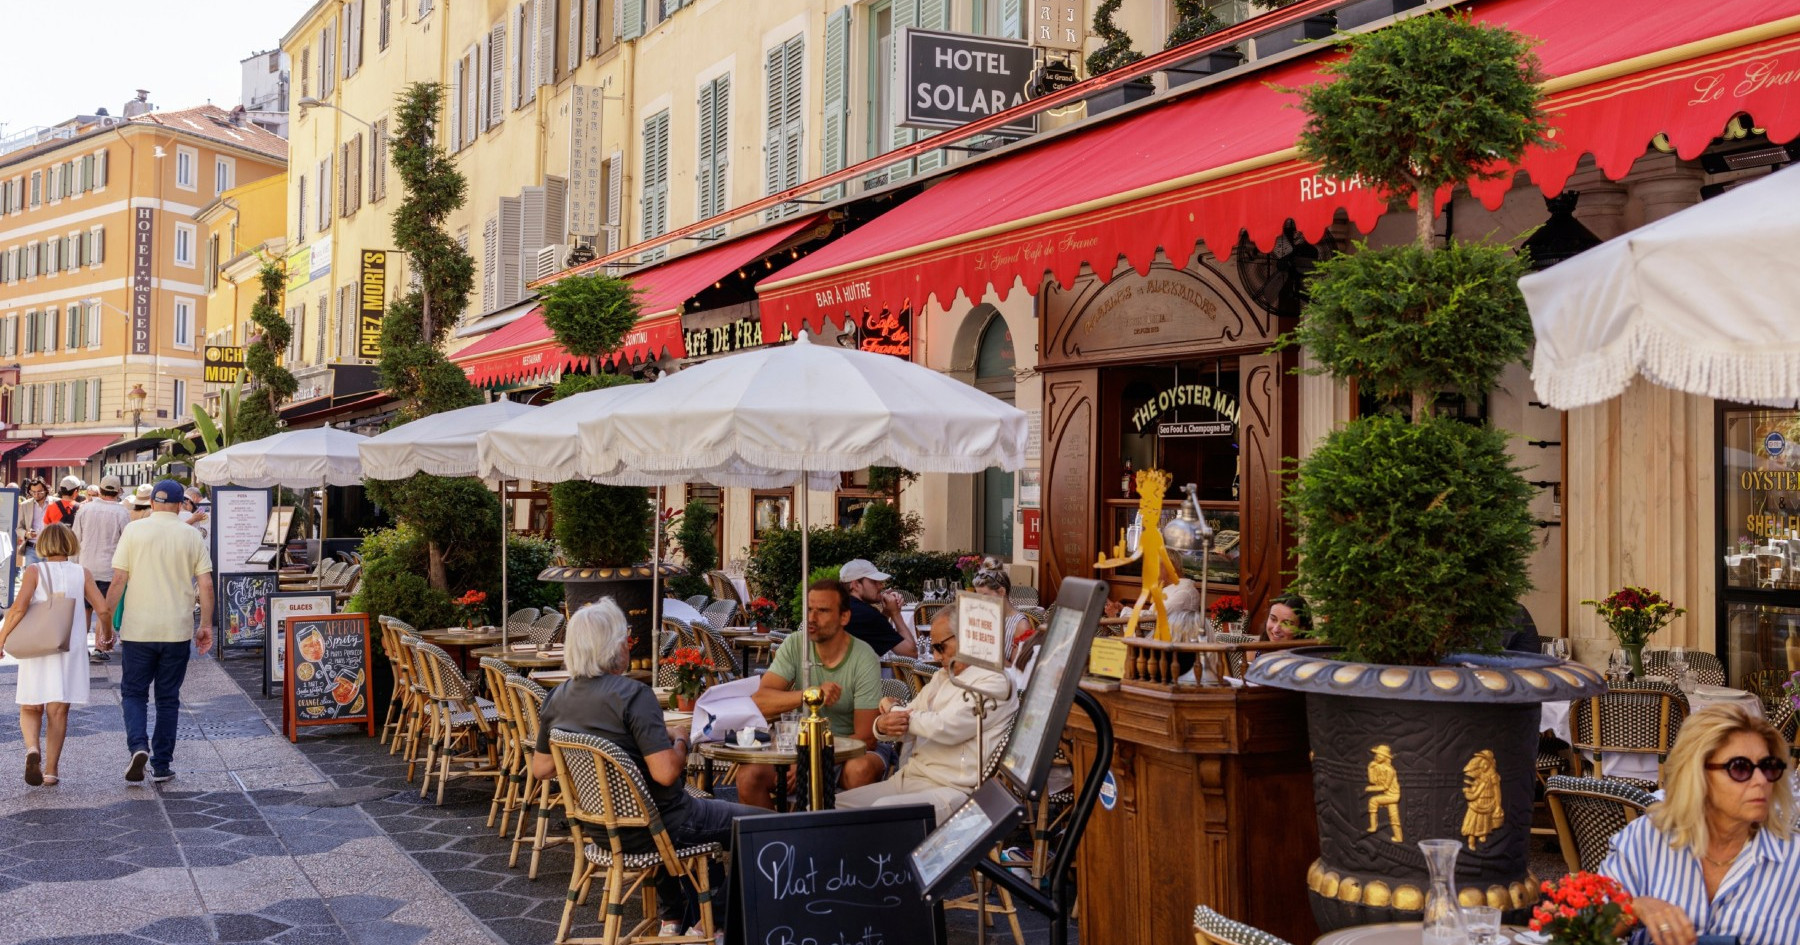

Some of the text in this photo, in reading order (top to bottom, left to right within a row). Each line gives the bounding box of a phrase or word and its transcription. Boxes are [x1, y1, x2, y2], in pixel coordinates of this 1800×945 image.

[935, 47, 1010, 76] HOTEL
[917, 82, 1026, 115] SOLARA
[1688, 73, 1725, 106] Le
[138, 209, 150, 267] HOTEL
[990, 246, 1021, 271] Grand
[1022, 241, 1043, 264] Café
[1044, 239, 1054, 256] de
[1059, 231, 1098, 252] France
[135, 284, 150, 292] de
[363, 252, 385, 311] MORI'S
[815, 290, 834, 308] BAR
[834, 285, 843, 304] À
[136, 294, 147, 353] SUEDE
[361, 316, 383, 356] CHEZ
[891, 326, 909, 341] de
[685, 328, 708, 357] AFÉ
[712, 324, 730, 352] DE
[225, 348, 243, 363] CH
[1132, 397, 1158, 432] THE
[1158, 384, 1211, 411] OYSTER
[1160, 425, 1169, 434] Sea
[1170, 425, 1183, 434] Food
[1188, 425, 1220, 434] Champagne
[1221, 424, 1231, 432] Bar
[1741, 471, 1800, 490] OYSTE
[1779, 497, 1786, 509] &
[1031, 517, 1040, 533] H
[325, 620, 361, 635] APEROL
[298, 698, 320, 707] ORANGE
[757, 841, 818, 900] Plat
[826, 858, 856, 891] du
